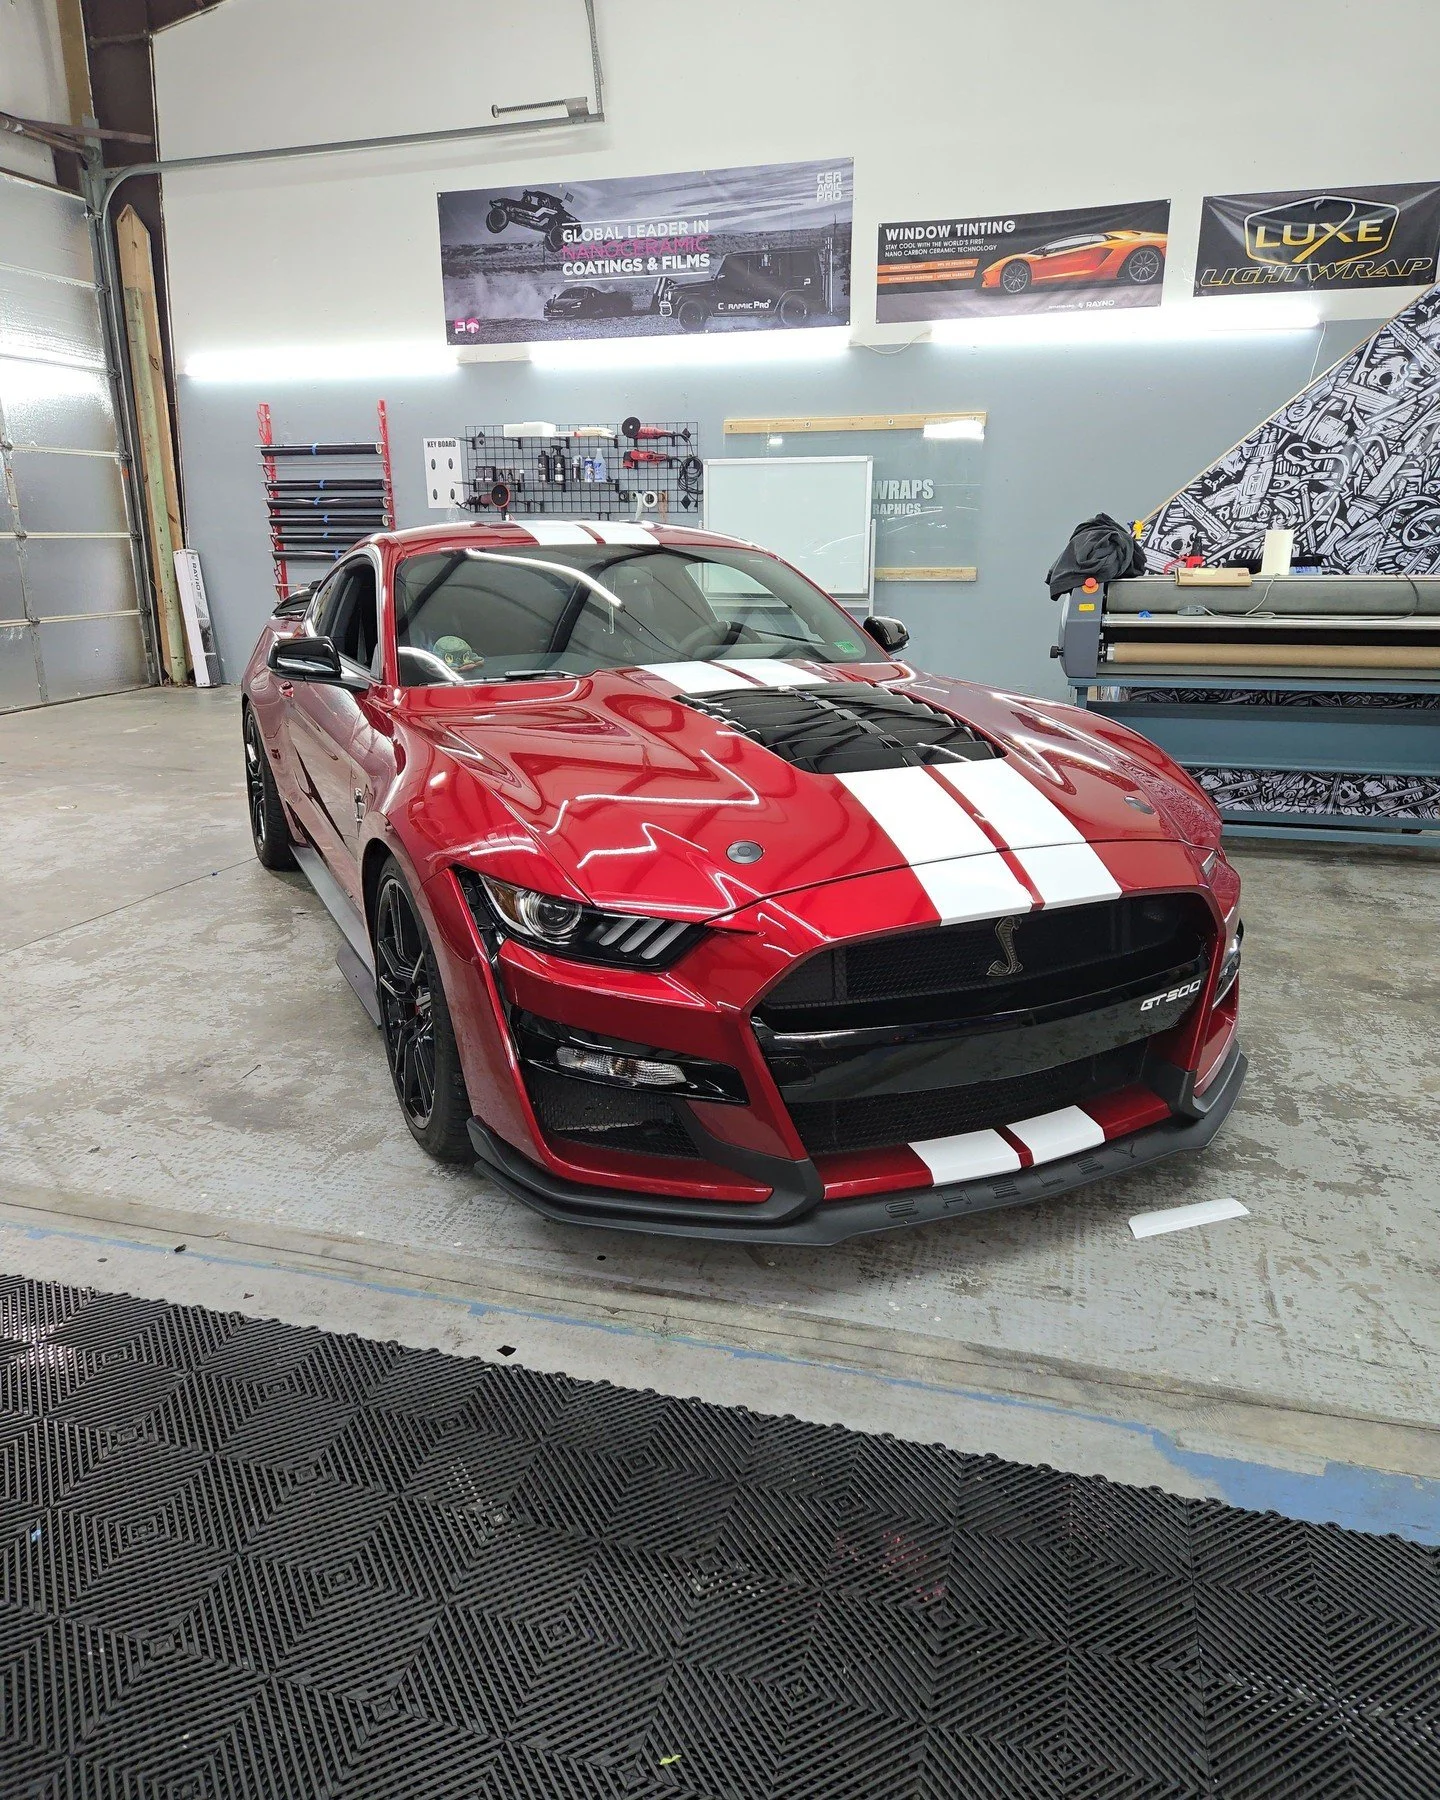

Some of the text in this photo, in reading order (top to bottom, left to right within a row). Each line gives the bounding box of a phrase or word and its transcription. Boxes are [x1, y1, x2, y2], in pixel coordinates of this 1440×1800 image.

[816, 171, 842, 184] CER
[816, 190, 843, 202] PRO
[562, 219, 709, 243] GLOBAL LEADER IN
[885, 220, 1016, 241] WINDOW TINTING
[1255, 218, 1384, 262] LUXE
[561, 235, 709, 260] NANOCERAMIC
[943, 239, 969, 247] WORLD'S
[957, 244, 998, 253] TECHNOLOGY
[562, 253, 710, 276] COATINGS & FILMS
[1200, 257, 1433, 287] LIGHTWRAP
[1086, 299, 1115, 308] RAYNO
[427, 440, 457, 448] KEY BOARD
[872, 478, 934, 500] WRAPS
[872, 502, 921, 515] RAPHICS
[1140, 979, 1202, 1012] GT500
